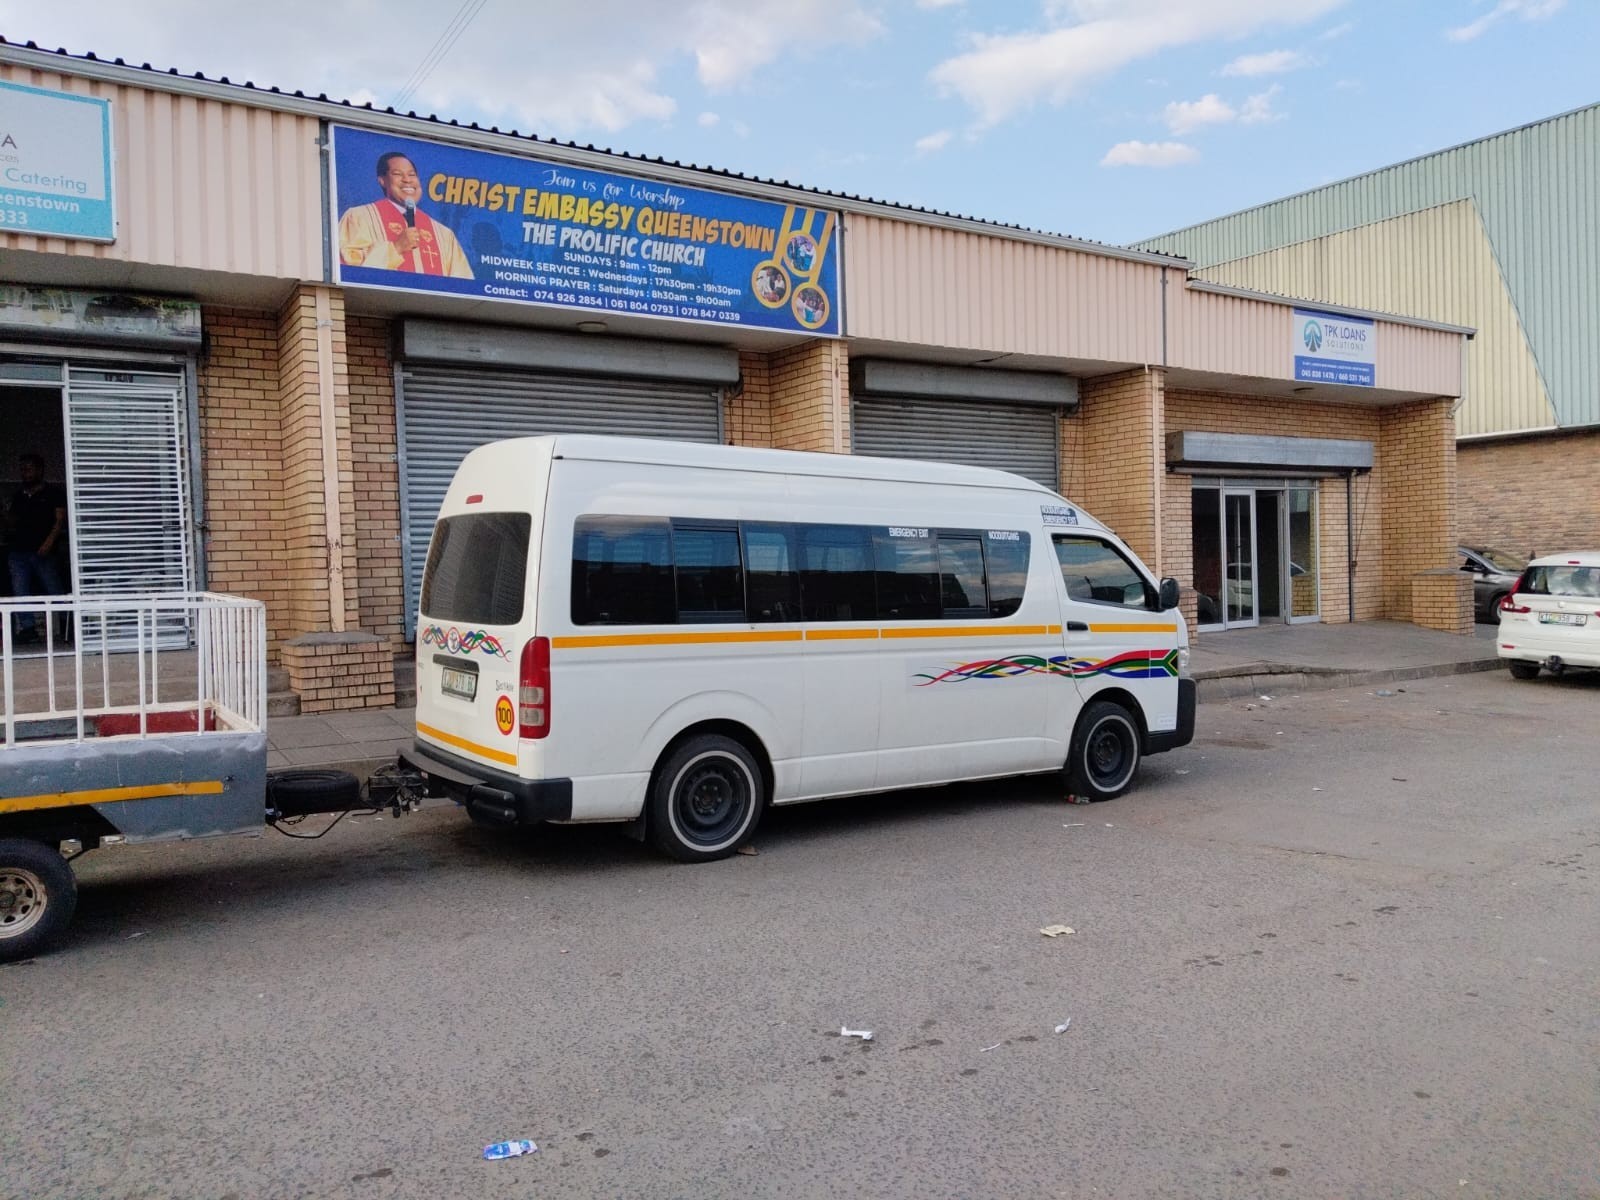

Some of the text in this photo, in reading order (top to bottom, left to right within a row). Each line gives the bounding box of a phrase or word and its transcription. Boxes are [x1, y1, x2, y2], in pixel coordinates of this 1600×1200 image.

[5, 168, 87, 194] Catering
[543, 169, 685, 210] Join us for Worship
[0, 193, 80, 213] enstown
[428, 173, 776, 253] CHRIST EMBASSY QUEENSTOWN
[522, 221, 706, 267] THE PROLIFIC CHURCH
[481, 255, 534, 270] MIDWEEK
[536, 262, 580, 277] SERVICE
[588, 269, 648, 285] Wednesdays
[655, 277, 695, 291] 17h30pm
[702, 283, 742, 297] 19h30pm
[564, 252, 612, 267] SUNDAYS
[619, 261, 640, 271] 9am
[648, 263, 672, 275] 12pm
[484, 284, 529, 298] Contact:
[534, 290, 554, 300] 074
[556, 292, 576, 303] 926
[578, 295, 603, 306] 2854
[611, 299, 628, 309] 061
[630, 301, 648, 311] 804
[650, 303, 674, 314] 0793
[681, 307, 699, 317] 078
[700, 309, 717, 319] 847
[719, 311, 741, 321] 0339
[495, 271, 547, 285] MORNING
[549, 277, 590, 291] PRAYER
[598, 283, 645, 298] Saturdays
[651, 290, 688, 302] 8h30am
[695, 295, 732, 307] 9h00am
[1324, 324, 1366, 342] TPK LOANS
[498, 707, 512, 725] 100
